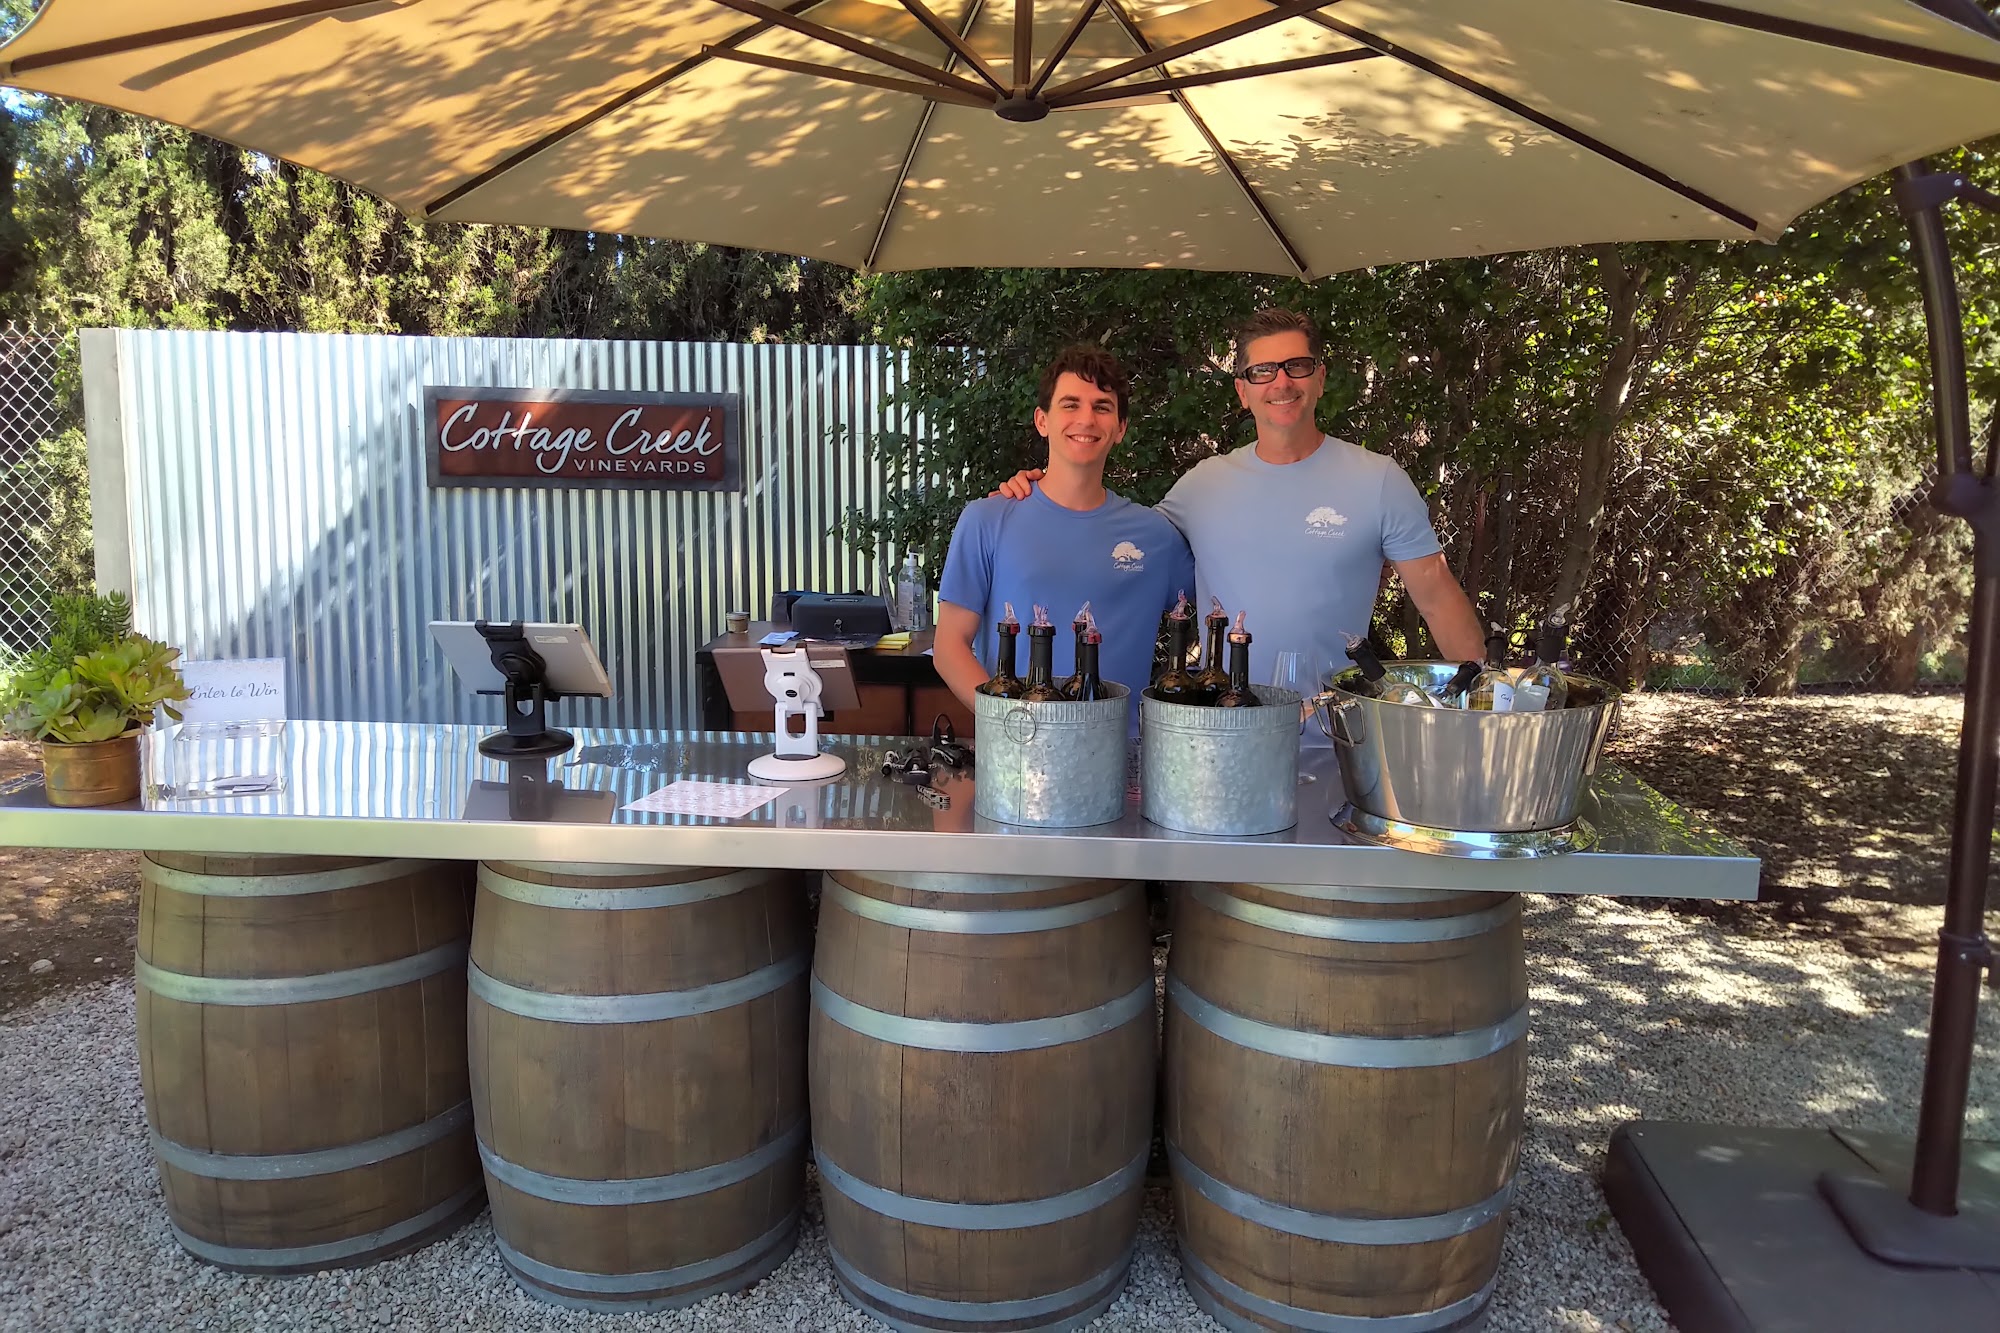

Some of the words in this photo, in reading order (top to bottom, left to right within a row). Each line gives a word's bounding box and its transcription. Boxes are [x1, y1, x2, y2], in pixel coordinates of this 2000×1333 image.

[441, 402, 597, 474] Cottage
[605, 406, 722, 456] Creek
[573, 459, 706, 474] VINEYARDS
[190, 685, 227, 700] Enter
[230, 685, 244, 698] to
[248, 682, 279, 698] Win
